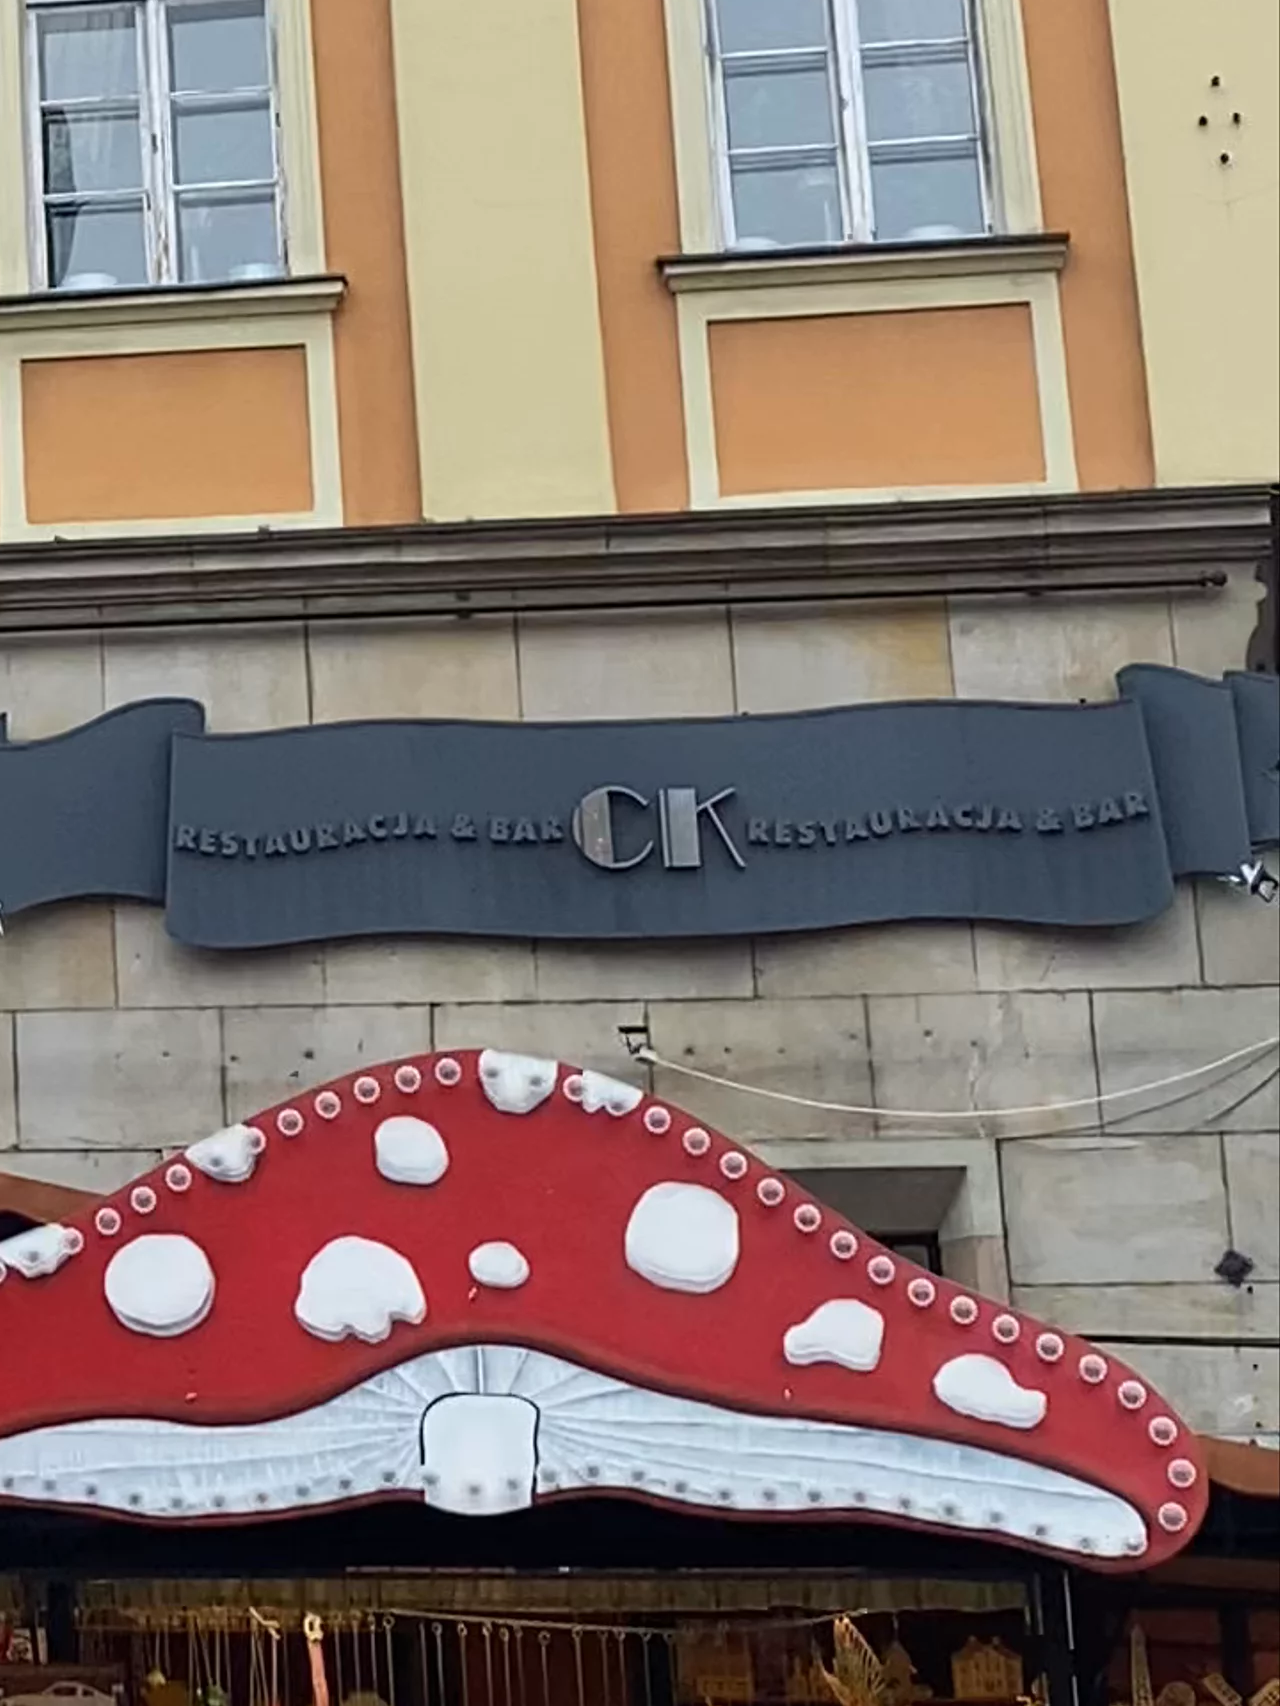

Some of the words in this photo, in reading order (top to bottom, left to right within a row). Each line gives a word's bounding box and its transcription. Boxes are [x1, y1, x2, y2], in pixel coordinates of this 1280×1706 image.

[172, 812, 438, 858] RESTAURACJA
[449, 813, 479, 842] &
[489, 815, 566, 844] BAR
[572, 785, 746, 869] CK
[746, 802, 1023, 848] RESTAURACJA
[1034, 805, 1064, 835] &
[1072, 791, 1151, 832] BAR
